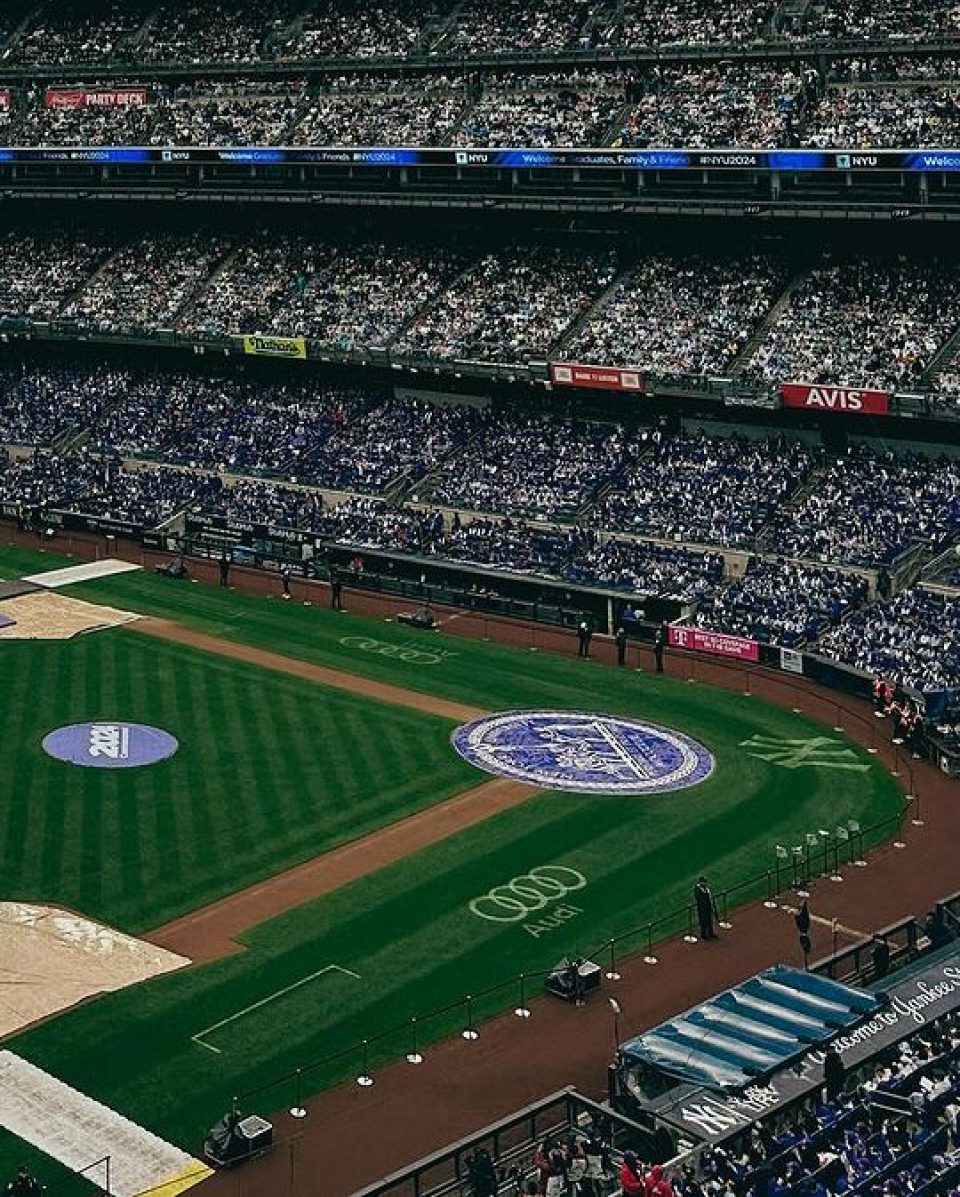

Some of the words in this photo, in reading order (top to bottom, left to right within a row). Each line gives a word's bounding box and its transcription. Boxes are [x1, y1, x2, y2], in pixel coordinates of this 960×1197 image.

[86, 93, 116, 106] PARTY
[117, 93, 144, 106] DECK
[172, 152, 189, 160] NYU
[218, 151, 252, 160] Welcome
[469, 154, 487, 163] NYU
[522, 154, 566, 163] Welcome
[618, 155, 647, 166] Family
[700, 156, 756, 165] #NYU2024
[853, 156, 877, 166] NYU
[806, 388, 862, 410] AVIS
[88, 725, 120, 759] 2024
[523, 903, 583, 938] Audi
[892, 981, 950, 1024] Yankee
